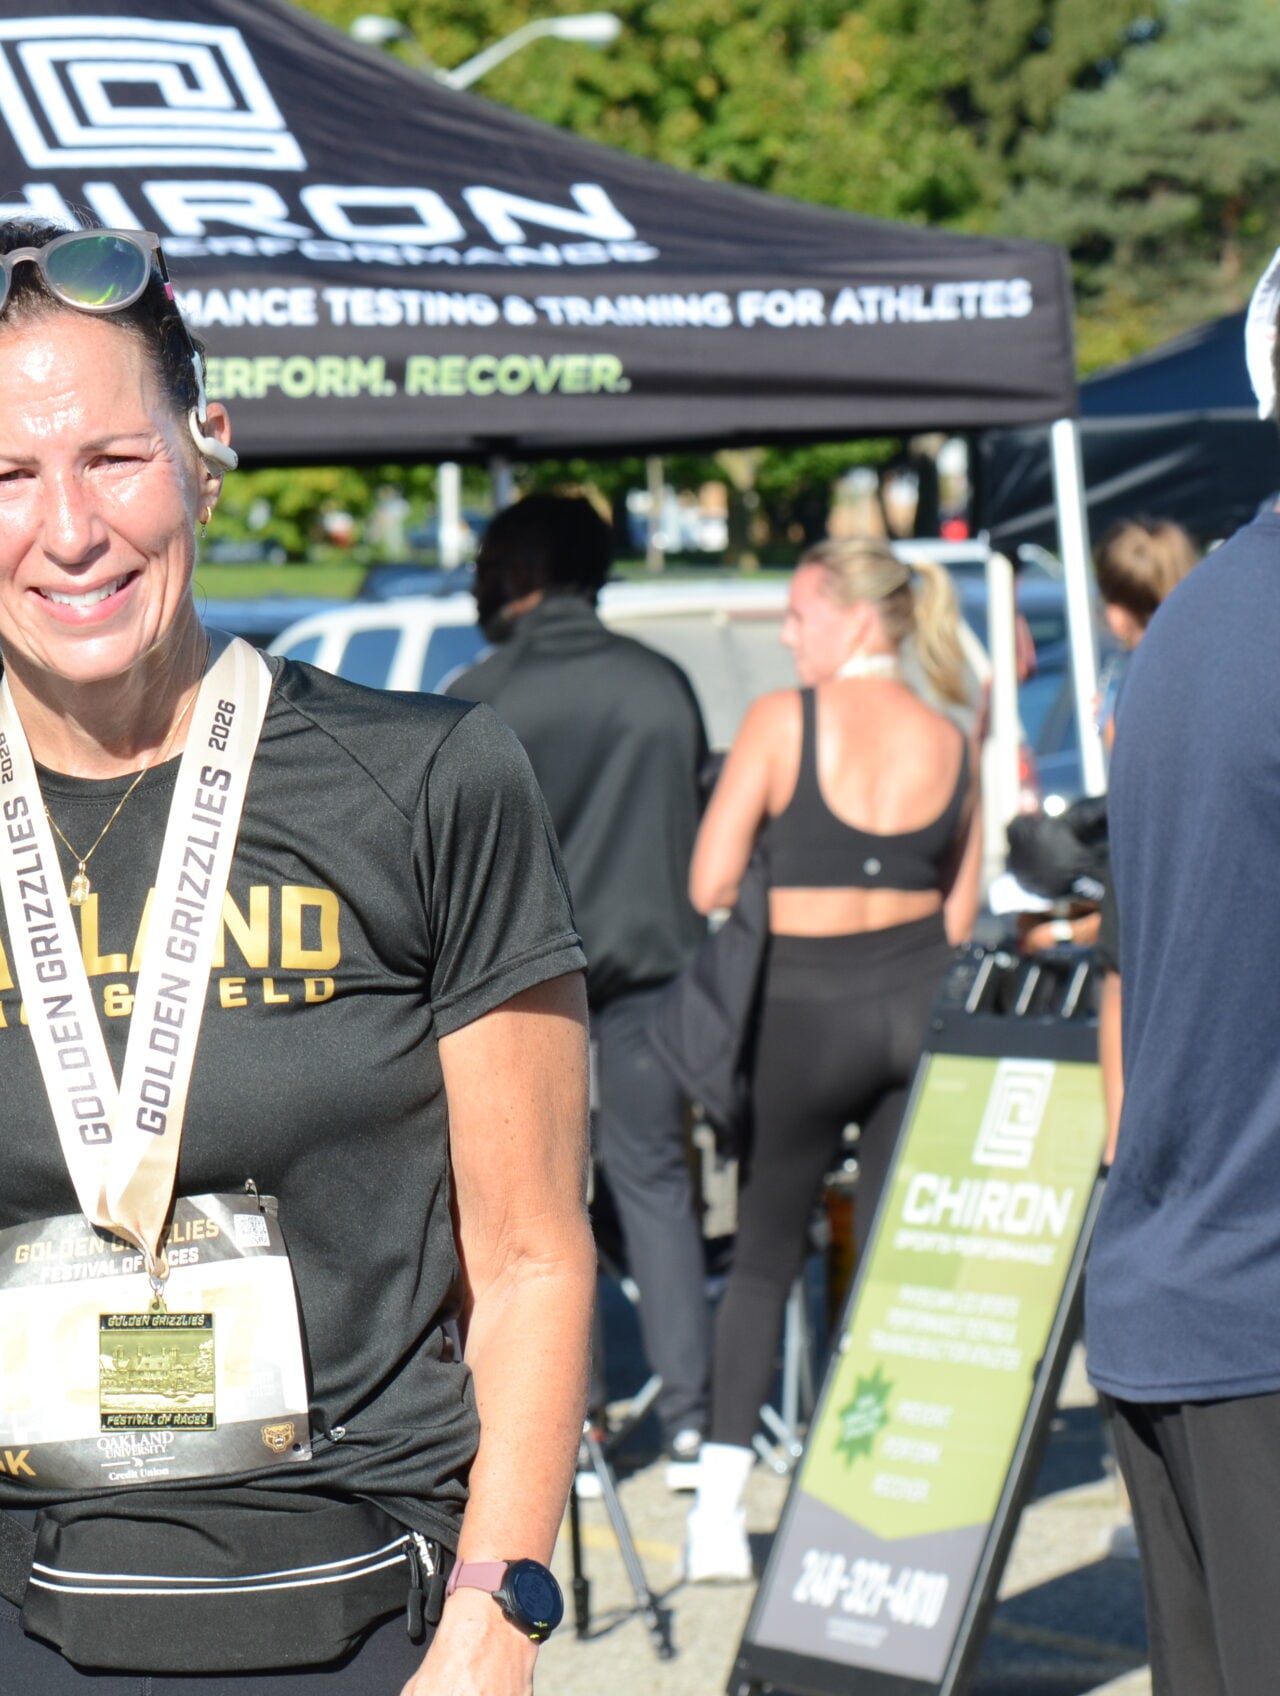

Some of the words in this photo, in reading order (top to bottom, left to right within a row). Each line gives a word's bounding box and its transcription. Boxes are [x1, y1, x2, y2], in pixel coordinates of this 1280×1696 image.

[161, 236, 660, 266] ERFORMANCE
[324, 288, 499, 327] TESTING
[504, 299, 537, 327] &
[537, 293, 733, 328] TRAINING
[738, 288, 827, 328] FOR
[831, 278, 1033, 325] ATHLETES
[206, 355, 397, 400] ERFORM.
[406, 353, 632, 398] RECOVER.
[3, 794, 68, 983] GRIZZLIES
[136, 972, 191, 1137] GOLDEN
[166, 765, 232, 964] GRIZZLIES
[208, 699, 236, 752] 2026
[104, 983, 134, 1017] &
[220, 976, 335, 1008] ELD
[42, 994, 113, 1146] GOLDEN
[901, 1171, 1074, 1239] CHIRON
[15, 1235, 104, 1265] GOLDEN
[39, 1259, 119, 1283] FESTIVAL
[122, 1256, 143, 1273] OF
[167, 1247, 199, 1266] CES
[107, 1315, 151, 1327] GOLDEN
[152, 1314, 205, 1326] GRIZZLIES
[107, 1414, 156, 1426] FESTIVAL
[157, 1414, 172, 1425] OF
[173, 1413, 208, 1425] RACES
[96, 1430, 174, 1450] OAKLAND
[108, 1468, 138, 1480] Credit
[140, 1467, 170, 1478] Union
